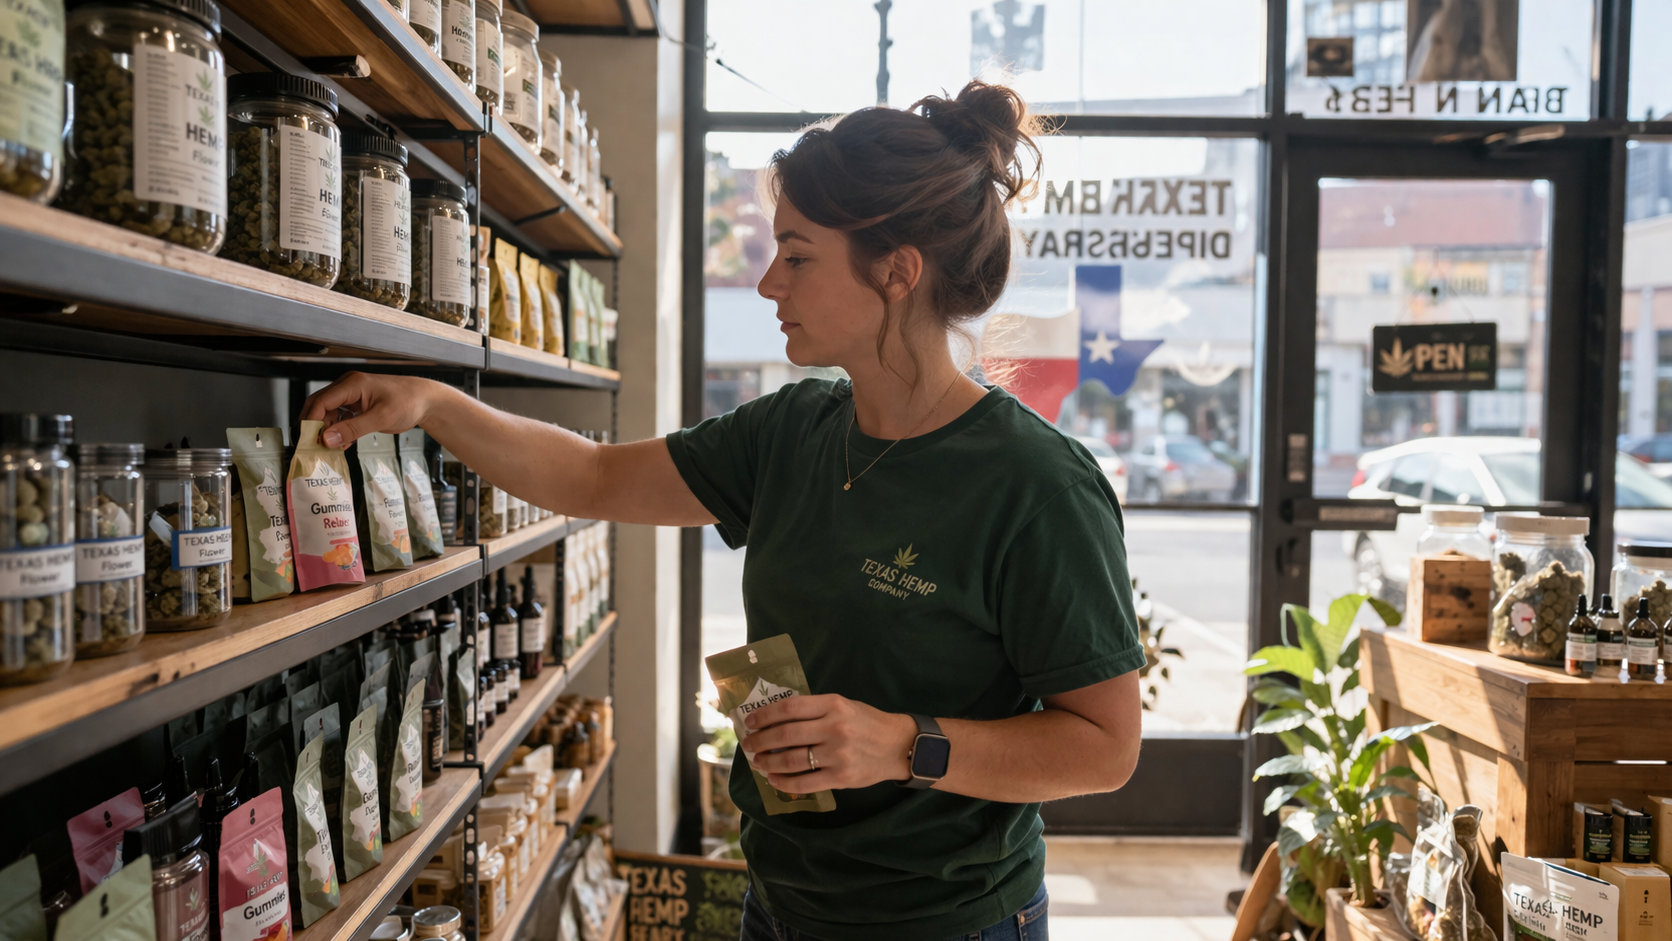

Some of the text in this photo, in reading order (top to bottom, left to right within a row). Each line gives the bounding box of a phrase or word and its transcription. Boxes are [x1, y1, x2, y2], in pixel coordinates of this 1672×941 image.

[183, 535, 216, 547] TEXAS
[82, 546, 120, 560] TEXAS
[101, 560, 133, 571] Flower
[861, 558, 937, 596] TEXAS HEMP
[868, 578, 910, 601] COMPANY
[739, 699, 768, 714] TEXAS
[617, 863, 687, 897] TEXAS
[243, 889, 286, 920] Gummies
[629, 896, 690, 926] HEMP
[1562, 905, 1603, 929] HEMP
